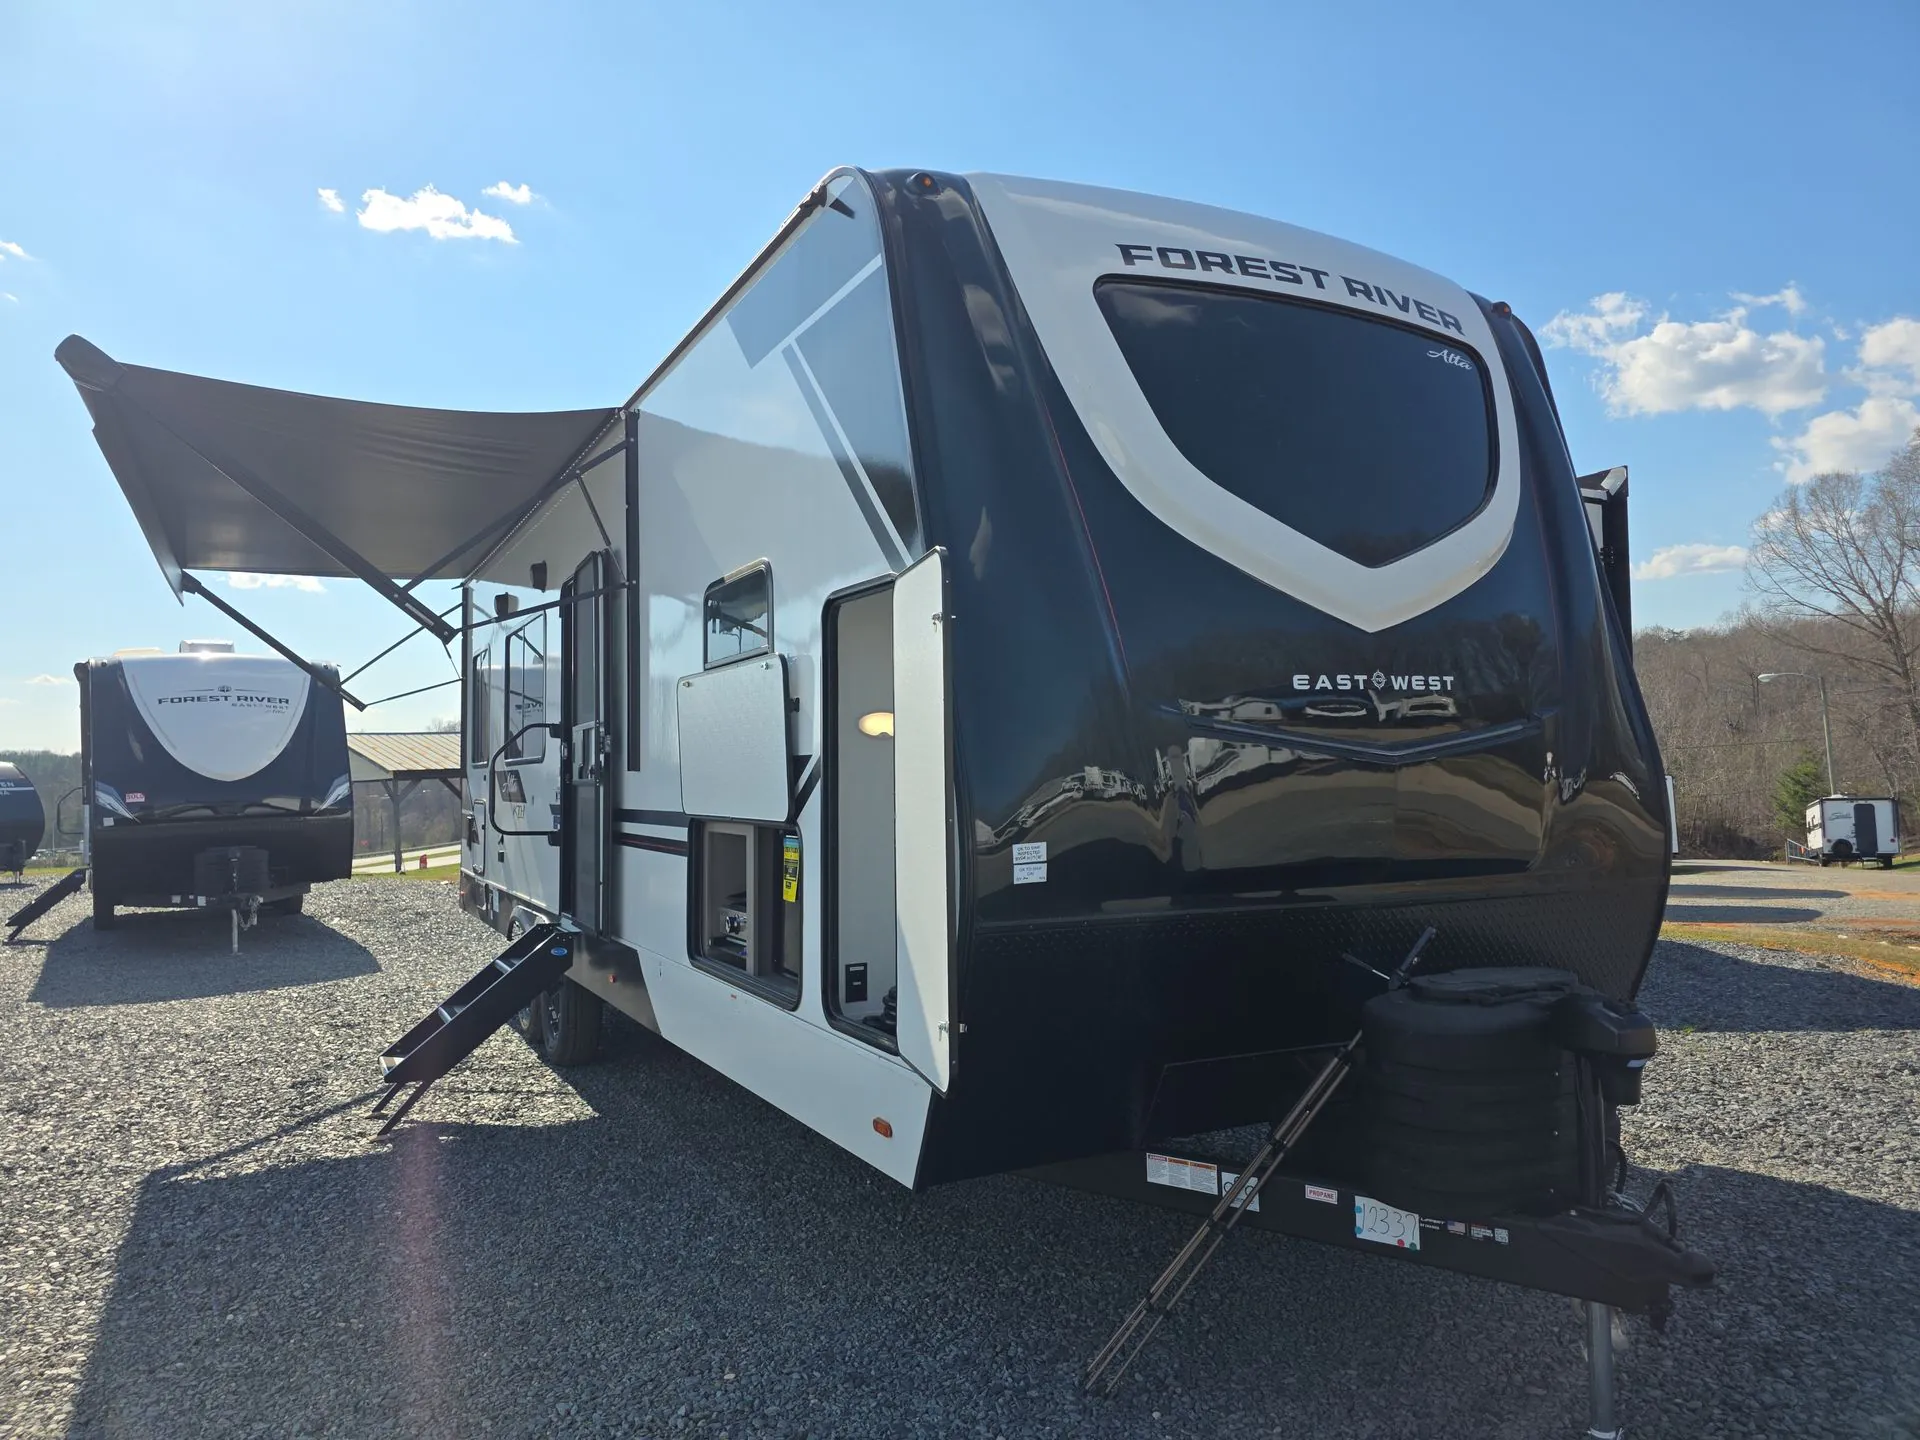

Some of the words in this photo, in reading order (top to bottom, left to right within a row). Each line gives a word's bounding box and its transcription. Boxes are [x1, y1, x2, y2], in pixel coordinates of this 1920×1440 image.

[1115, 243, 1329, 290] FOREST
[1338, 275, 1466, 336] RIVER
[1426, 349, 1473, 370] Alta
[1292, 674, 1368, 690] EAST
[1391, 675, 1454, 691] WEST
[157, 695, 232, 704] FOREST
[236, 695, 290, 704] RIVER
[1309, 1189, 1335, 1200] PROPANE
[1363, 1203, 1417, 1241] 12337
